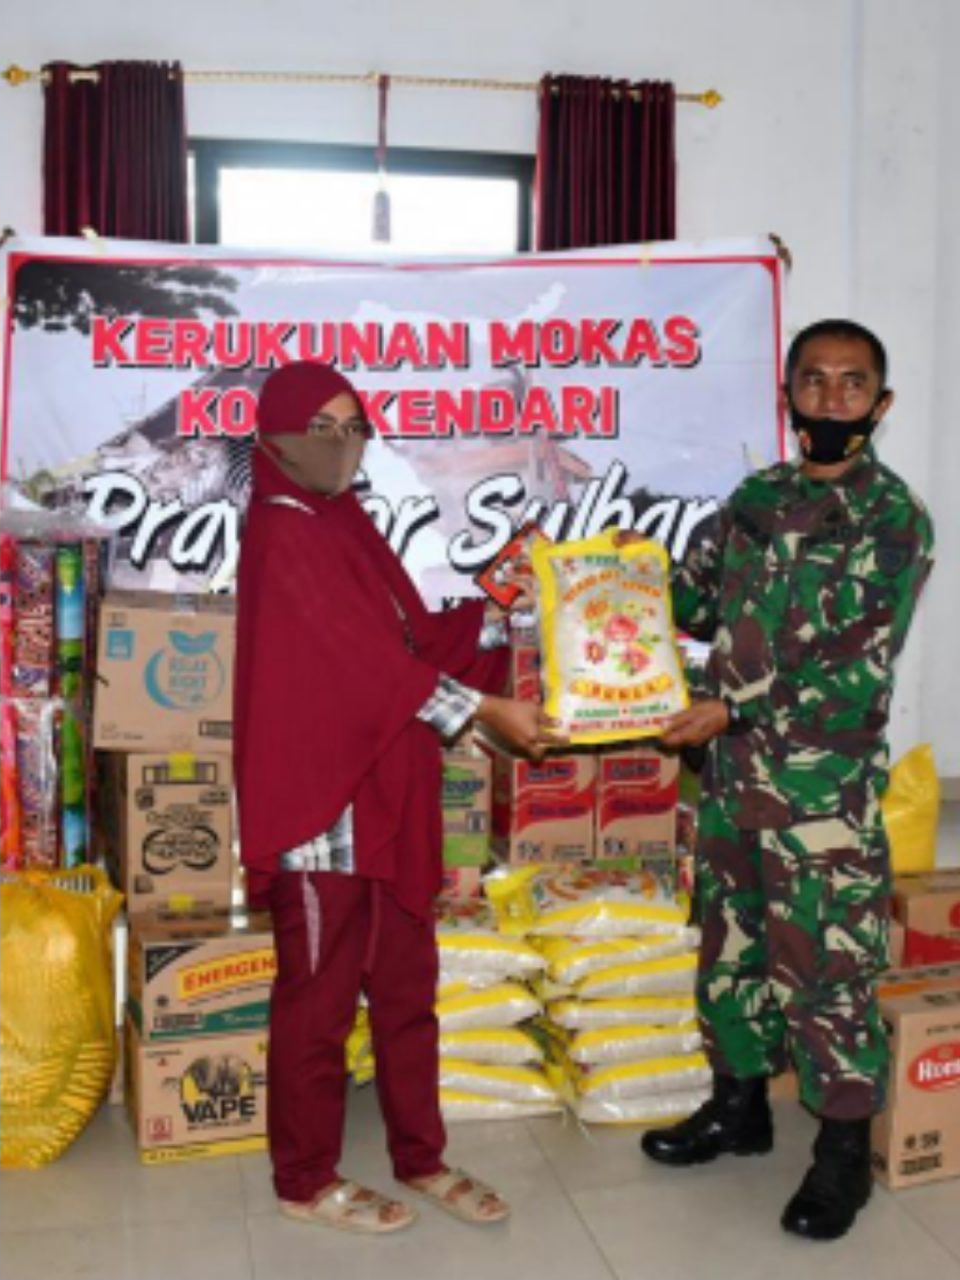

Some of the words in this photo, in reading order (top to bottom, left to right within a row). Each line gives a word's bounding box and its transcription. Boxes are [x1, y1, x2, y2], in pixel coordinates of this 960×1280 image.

[90, 315, 470, 370] KERUKUNAN
[487, 314, 702, 369] MOKAS
[360, 385, 620, 440] KENDARI
[447, 459, 721, 573] Sulbar
[181, 1095, 257, 1124] VAPE
